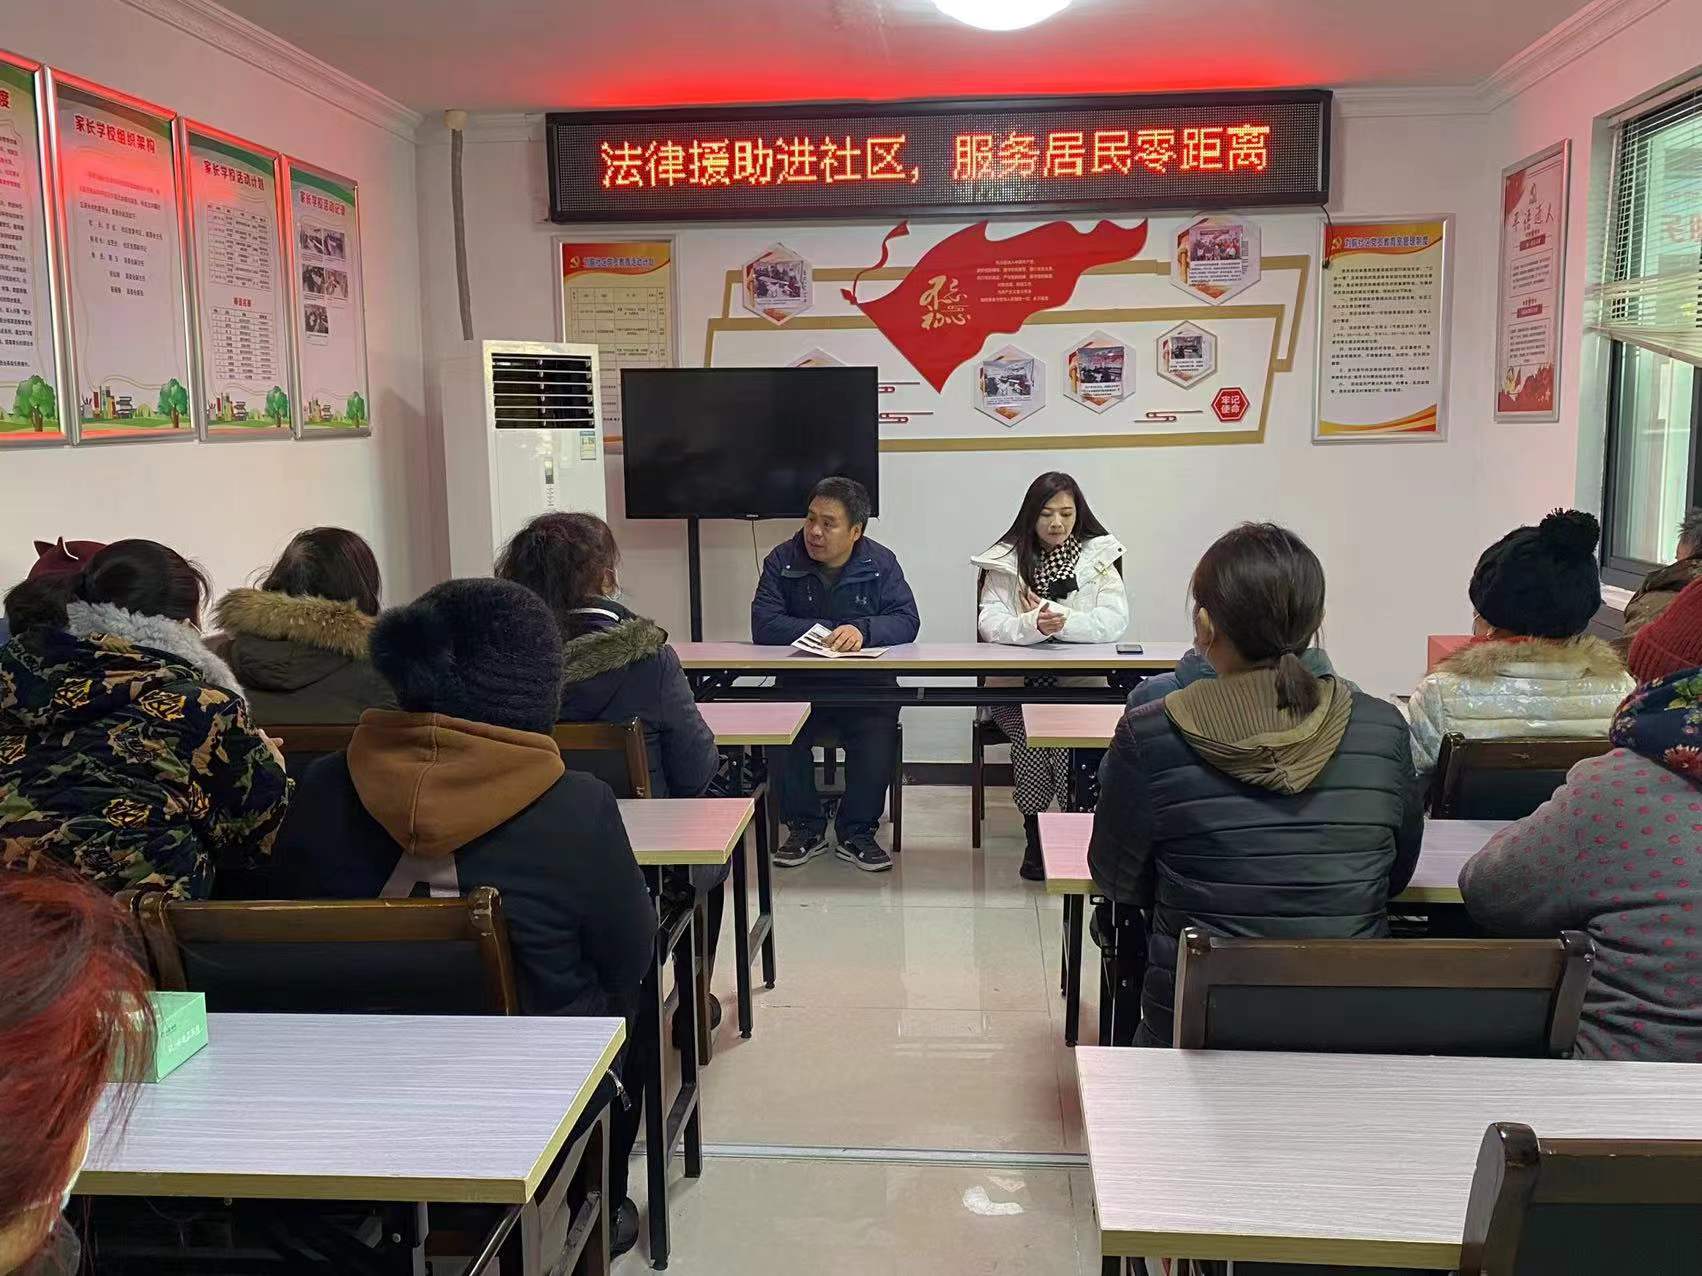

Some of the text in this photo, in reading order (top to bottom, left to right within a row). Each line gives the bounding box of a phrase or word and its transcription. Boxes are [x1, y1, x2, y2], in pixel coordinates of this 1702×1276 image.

[73, 114, 156, 154] 家长学校组织架构
[202, 160, 265, 191] 家长学校活动计划
